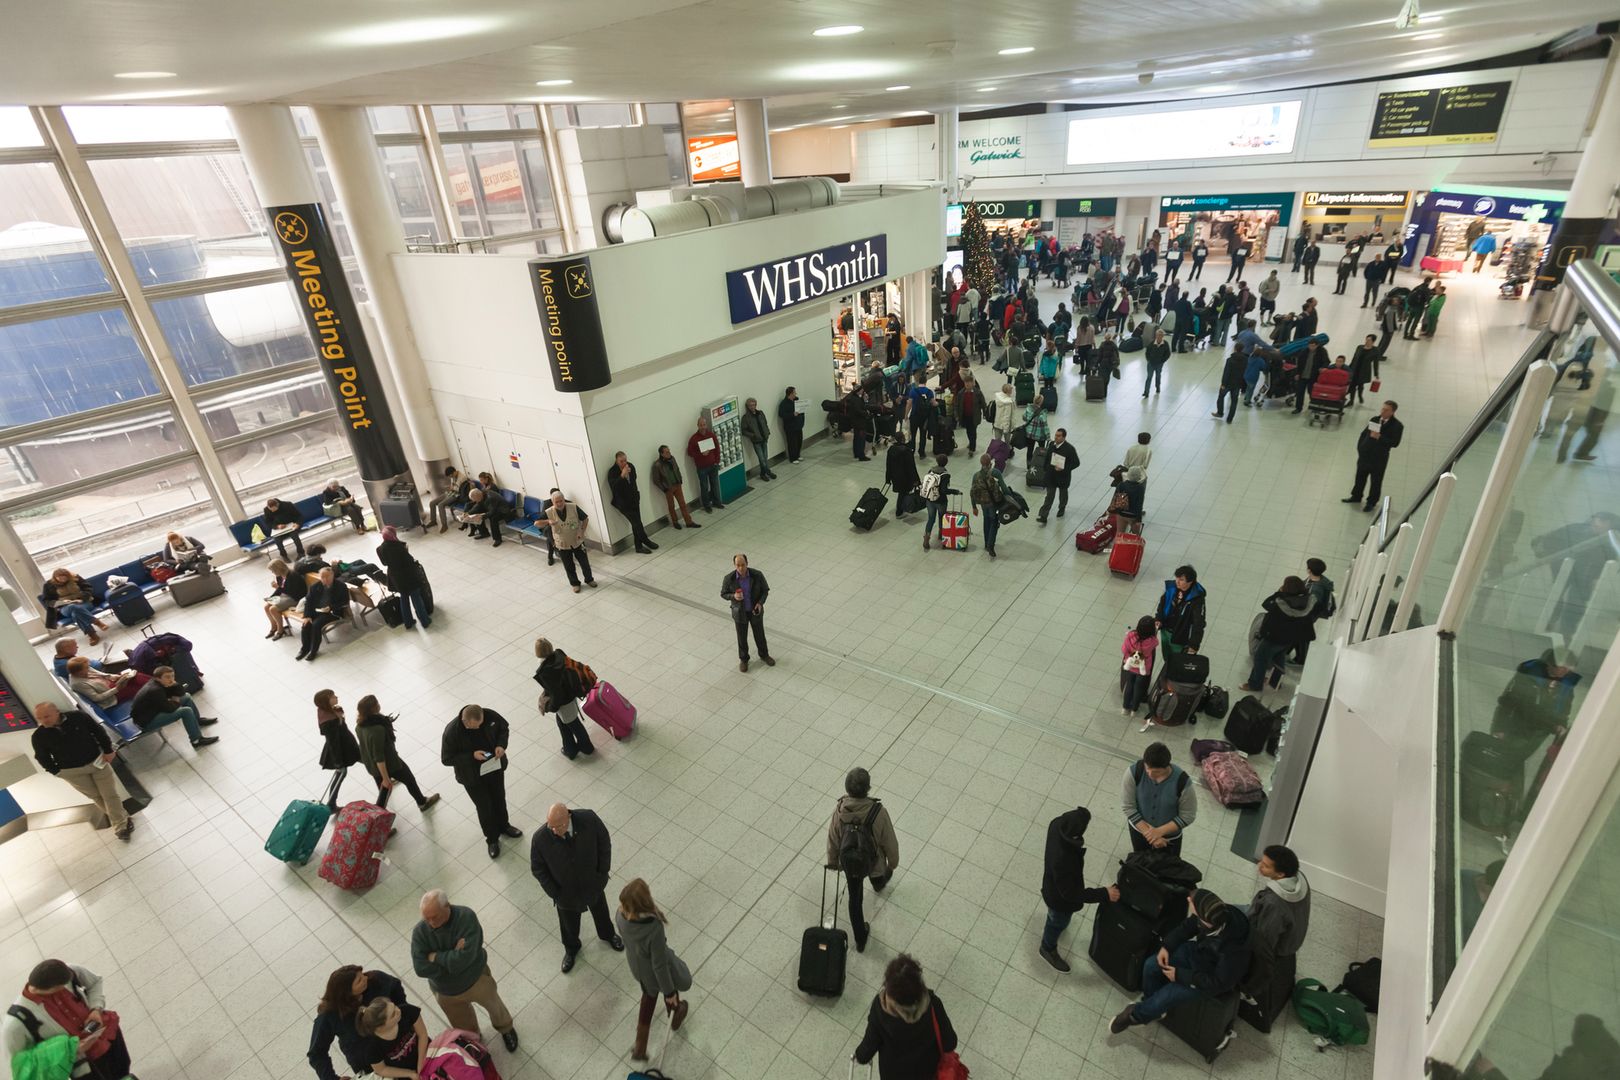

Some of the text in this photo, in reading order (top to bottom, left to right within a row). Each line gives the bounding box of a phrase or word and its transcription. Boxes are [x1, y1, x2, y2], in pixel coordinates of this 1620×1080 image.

[970, 147, 1025, 165] Gatwick
[972, 136, 1021, 148] WELCOME
[1317, 193, 1350, 204] Airport
[743, 240, 881, 315] WHSmith
[291, 249, 373, 431] Meeting Point
[538, 268, 574, 382] Meeting point
